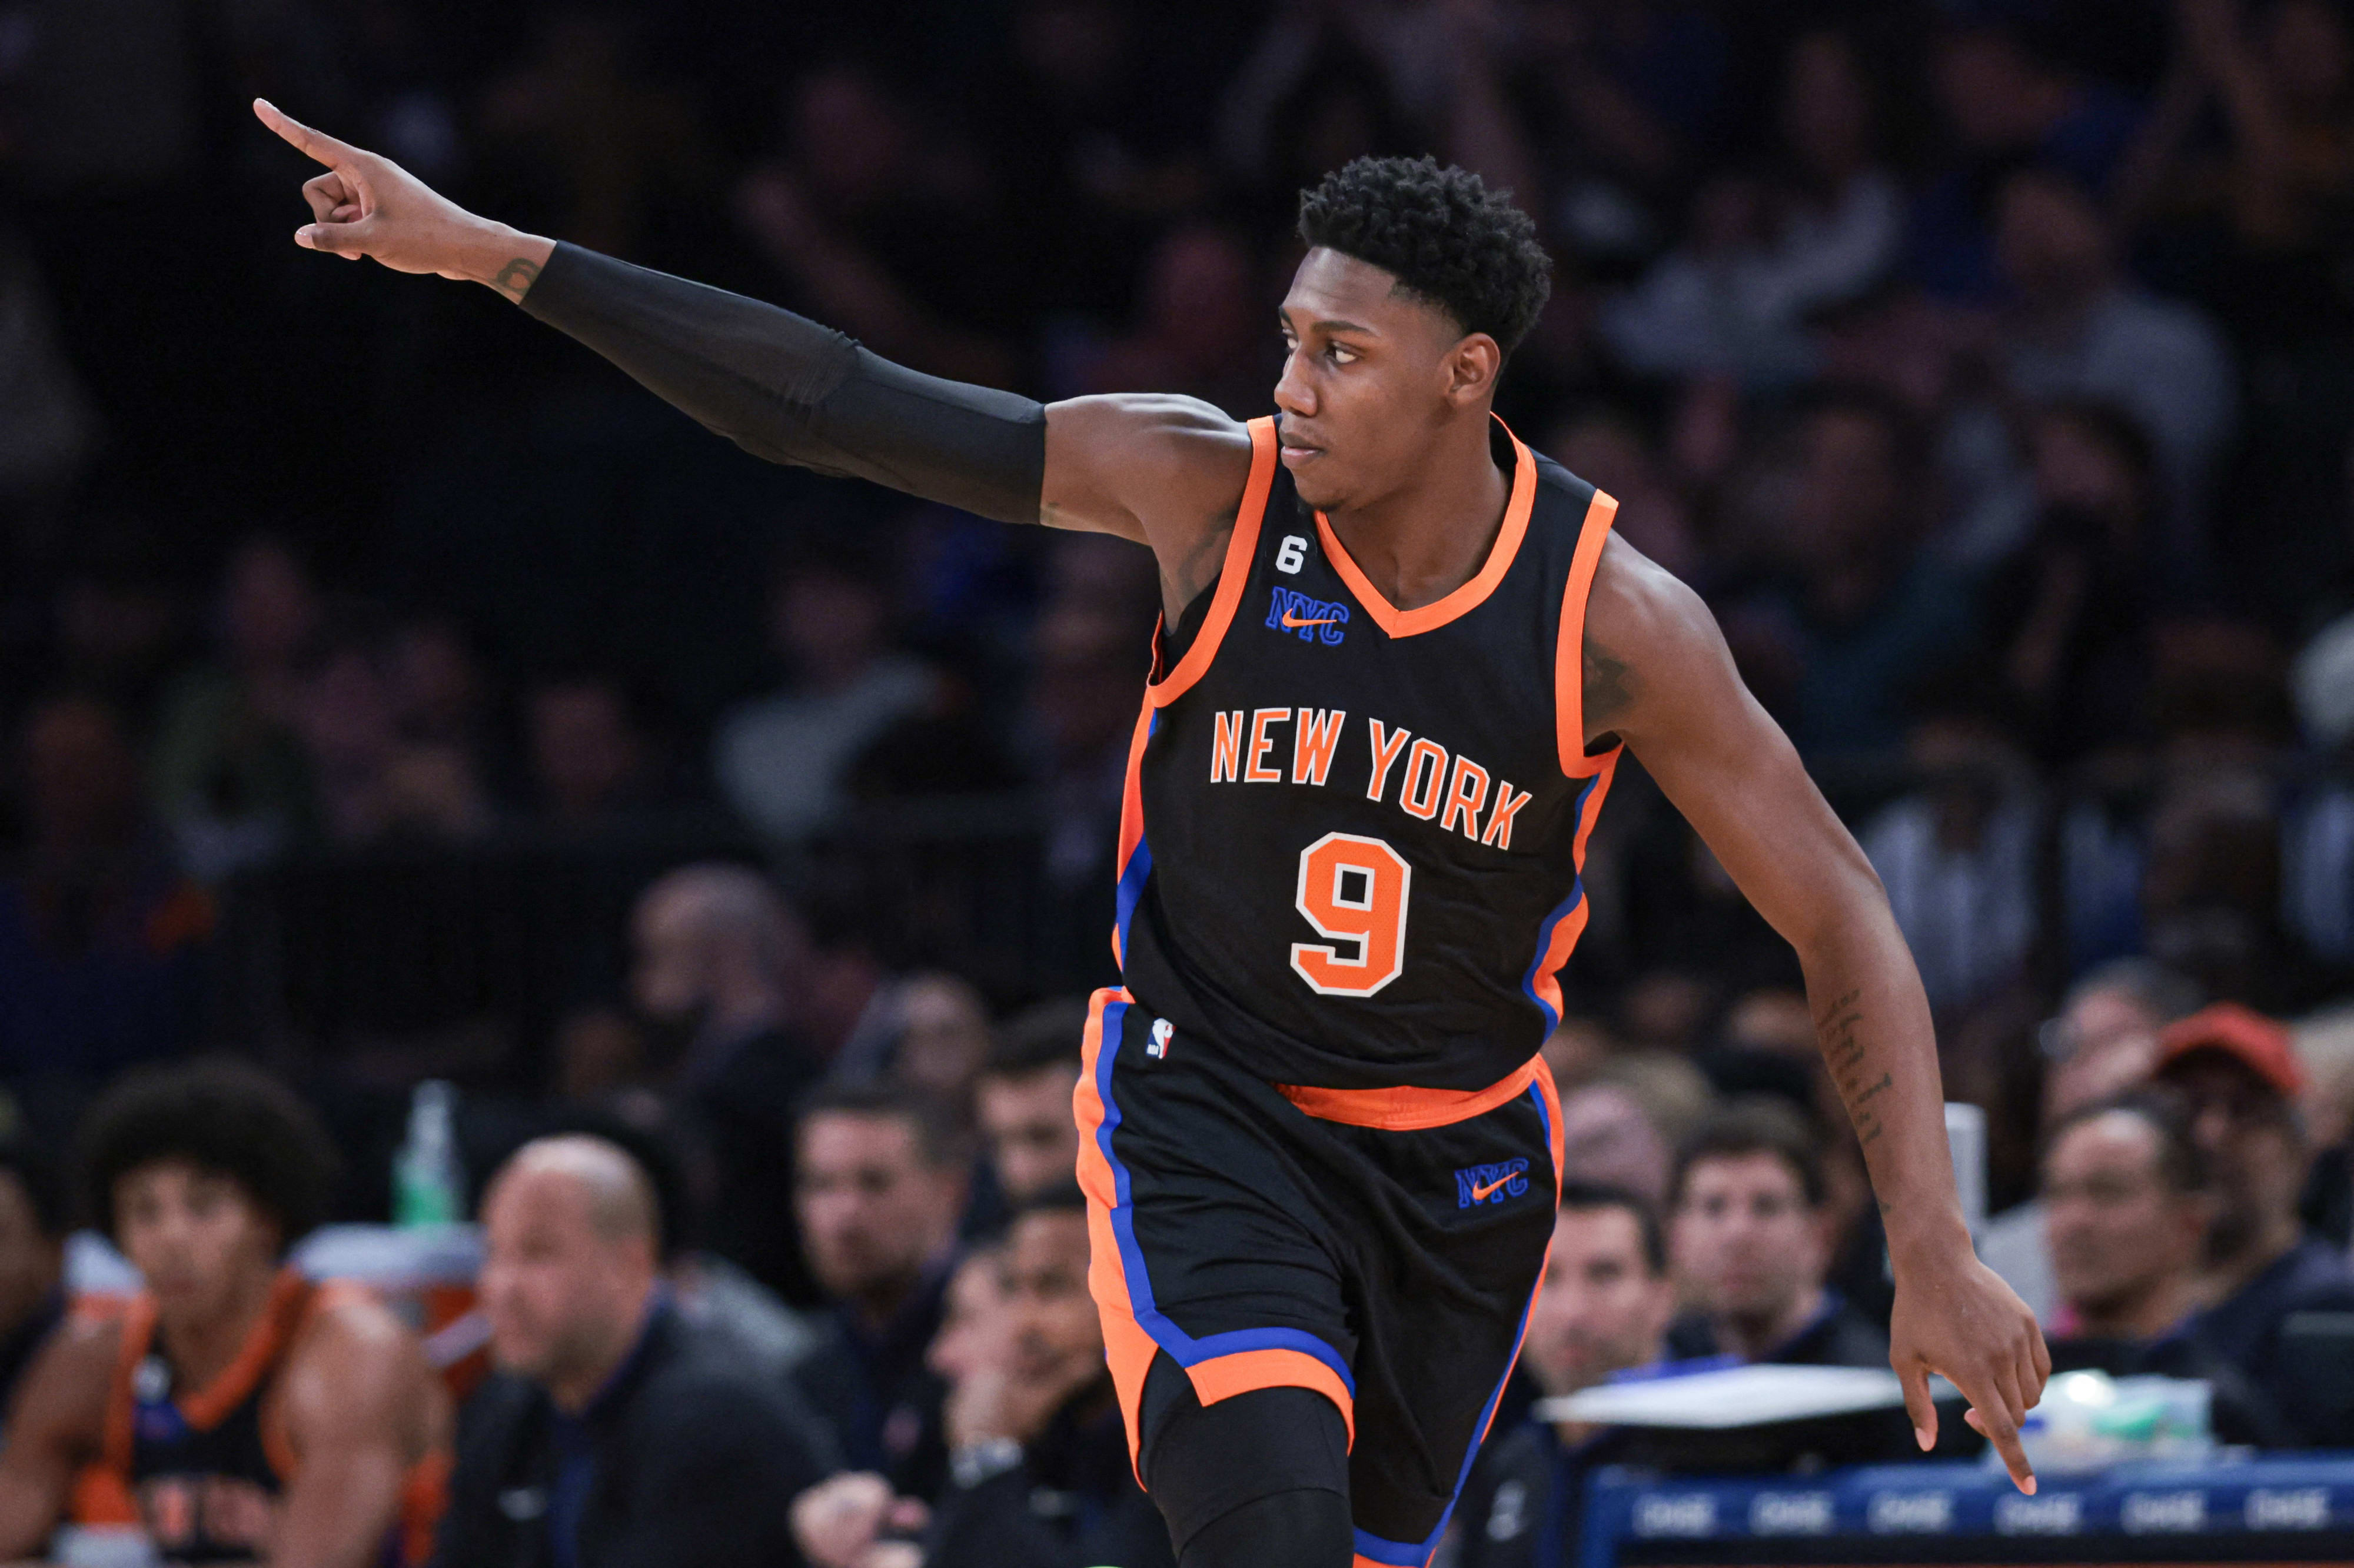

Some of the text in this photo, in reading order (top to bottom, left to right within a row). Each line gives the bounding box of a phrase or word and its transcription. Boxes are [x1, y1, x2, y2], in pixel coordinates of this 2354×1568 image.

[1275, 534, 1308, 574] 6
[1265, 586, 1350, 646] NYC
[1211, 707, 1532, 851] NEW YORK
[1290, 831, 1411, 998] 9
[1454, 1157, 1530, 1209] NYC
